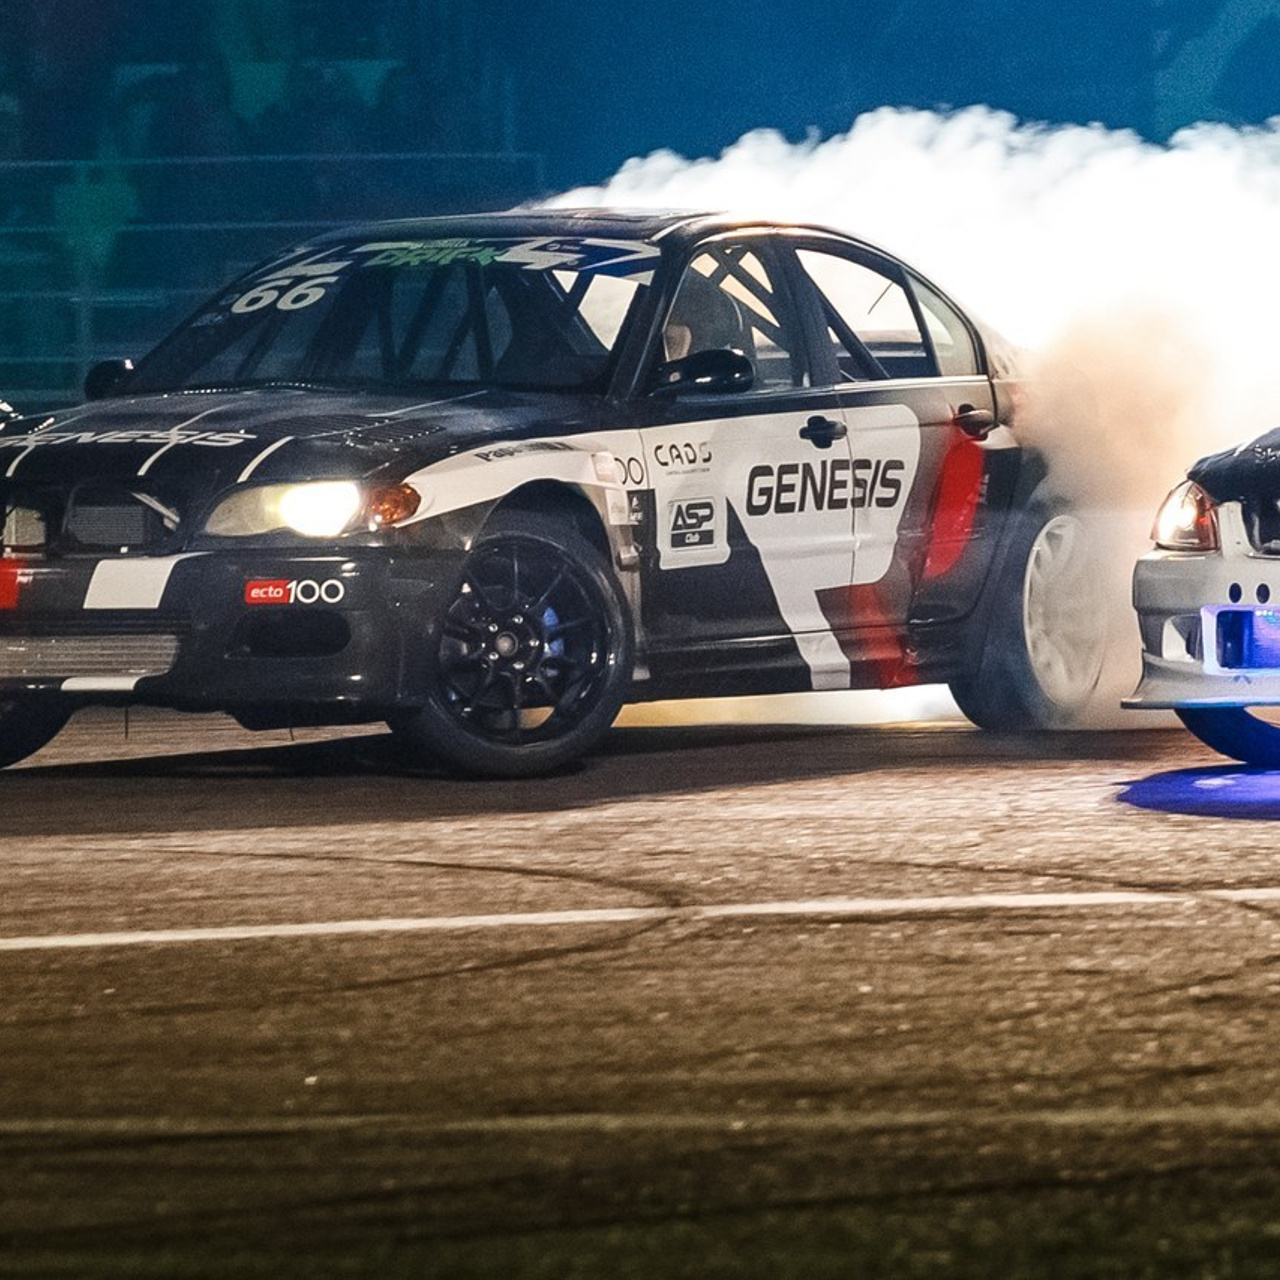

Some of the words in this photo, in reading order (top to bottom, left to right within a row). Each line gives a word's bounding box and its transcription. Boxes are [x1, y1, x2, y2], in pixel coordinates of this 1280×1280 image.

[231, 276, 339, 314] 66
[746, 458, 905, 516] GENESIS
[671, 502, 714, 532] ASP
